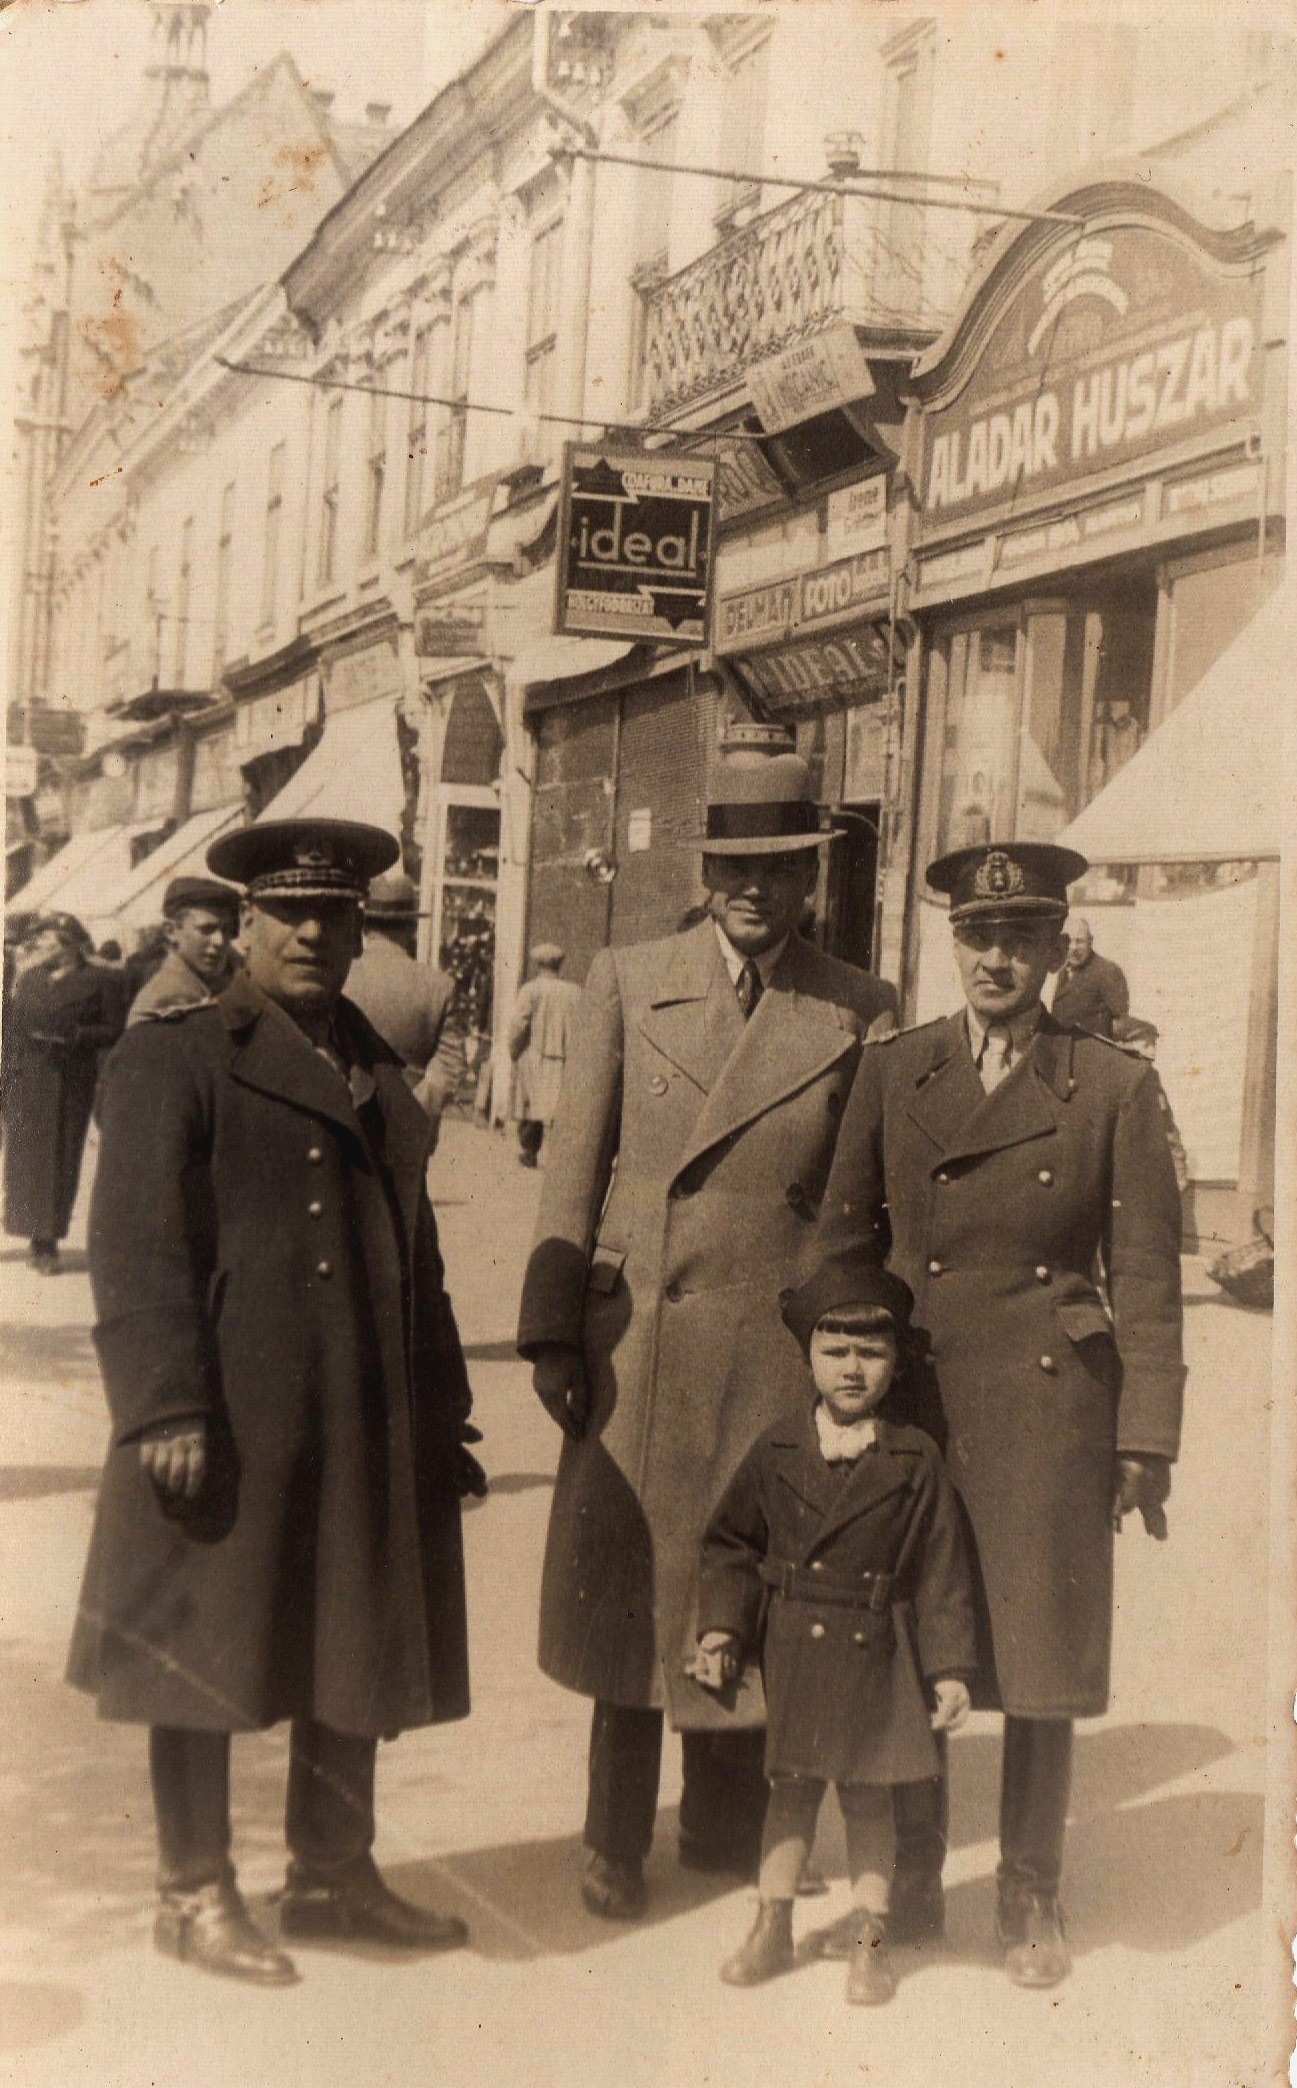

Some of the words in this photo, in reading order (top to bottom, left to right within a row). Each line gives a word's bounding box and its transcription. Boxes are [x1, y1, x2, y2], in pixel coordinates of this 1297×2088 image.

[928, 393, 1060, 509] ALADAR
[1071, 318, 1253, 459] HUSZAR
[579, 501, 699, 568] ideal
